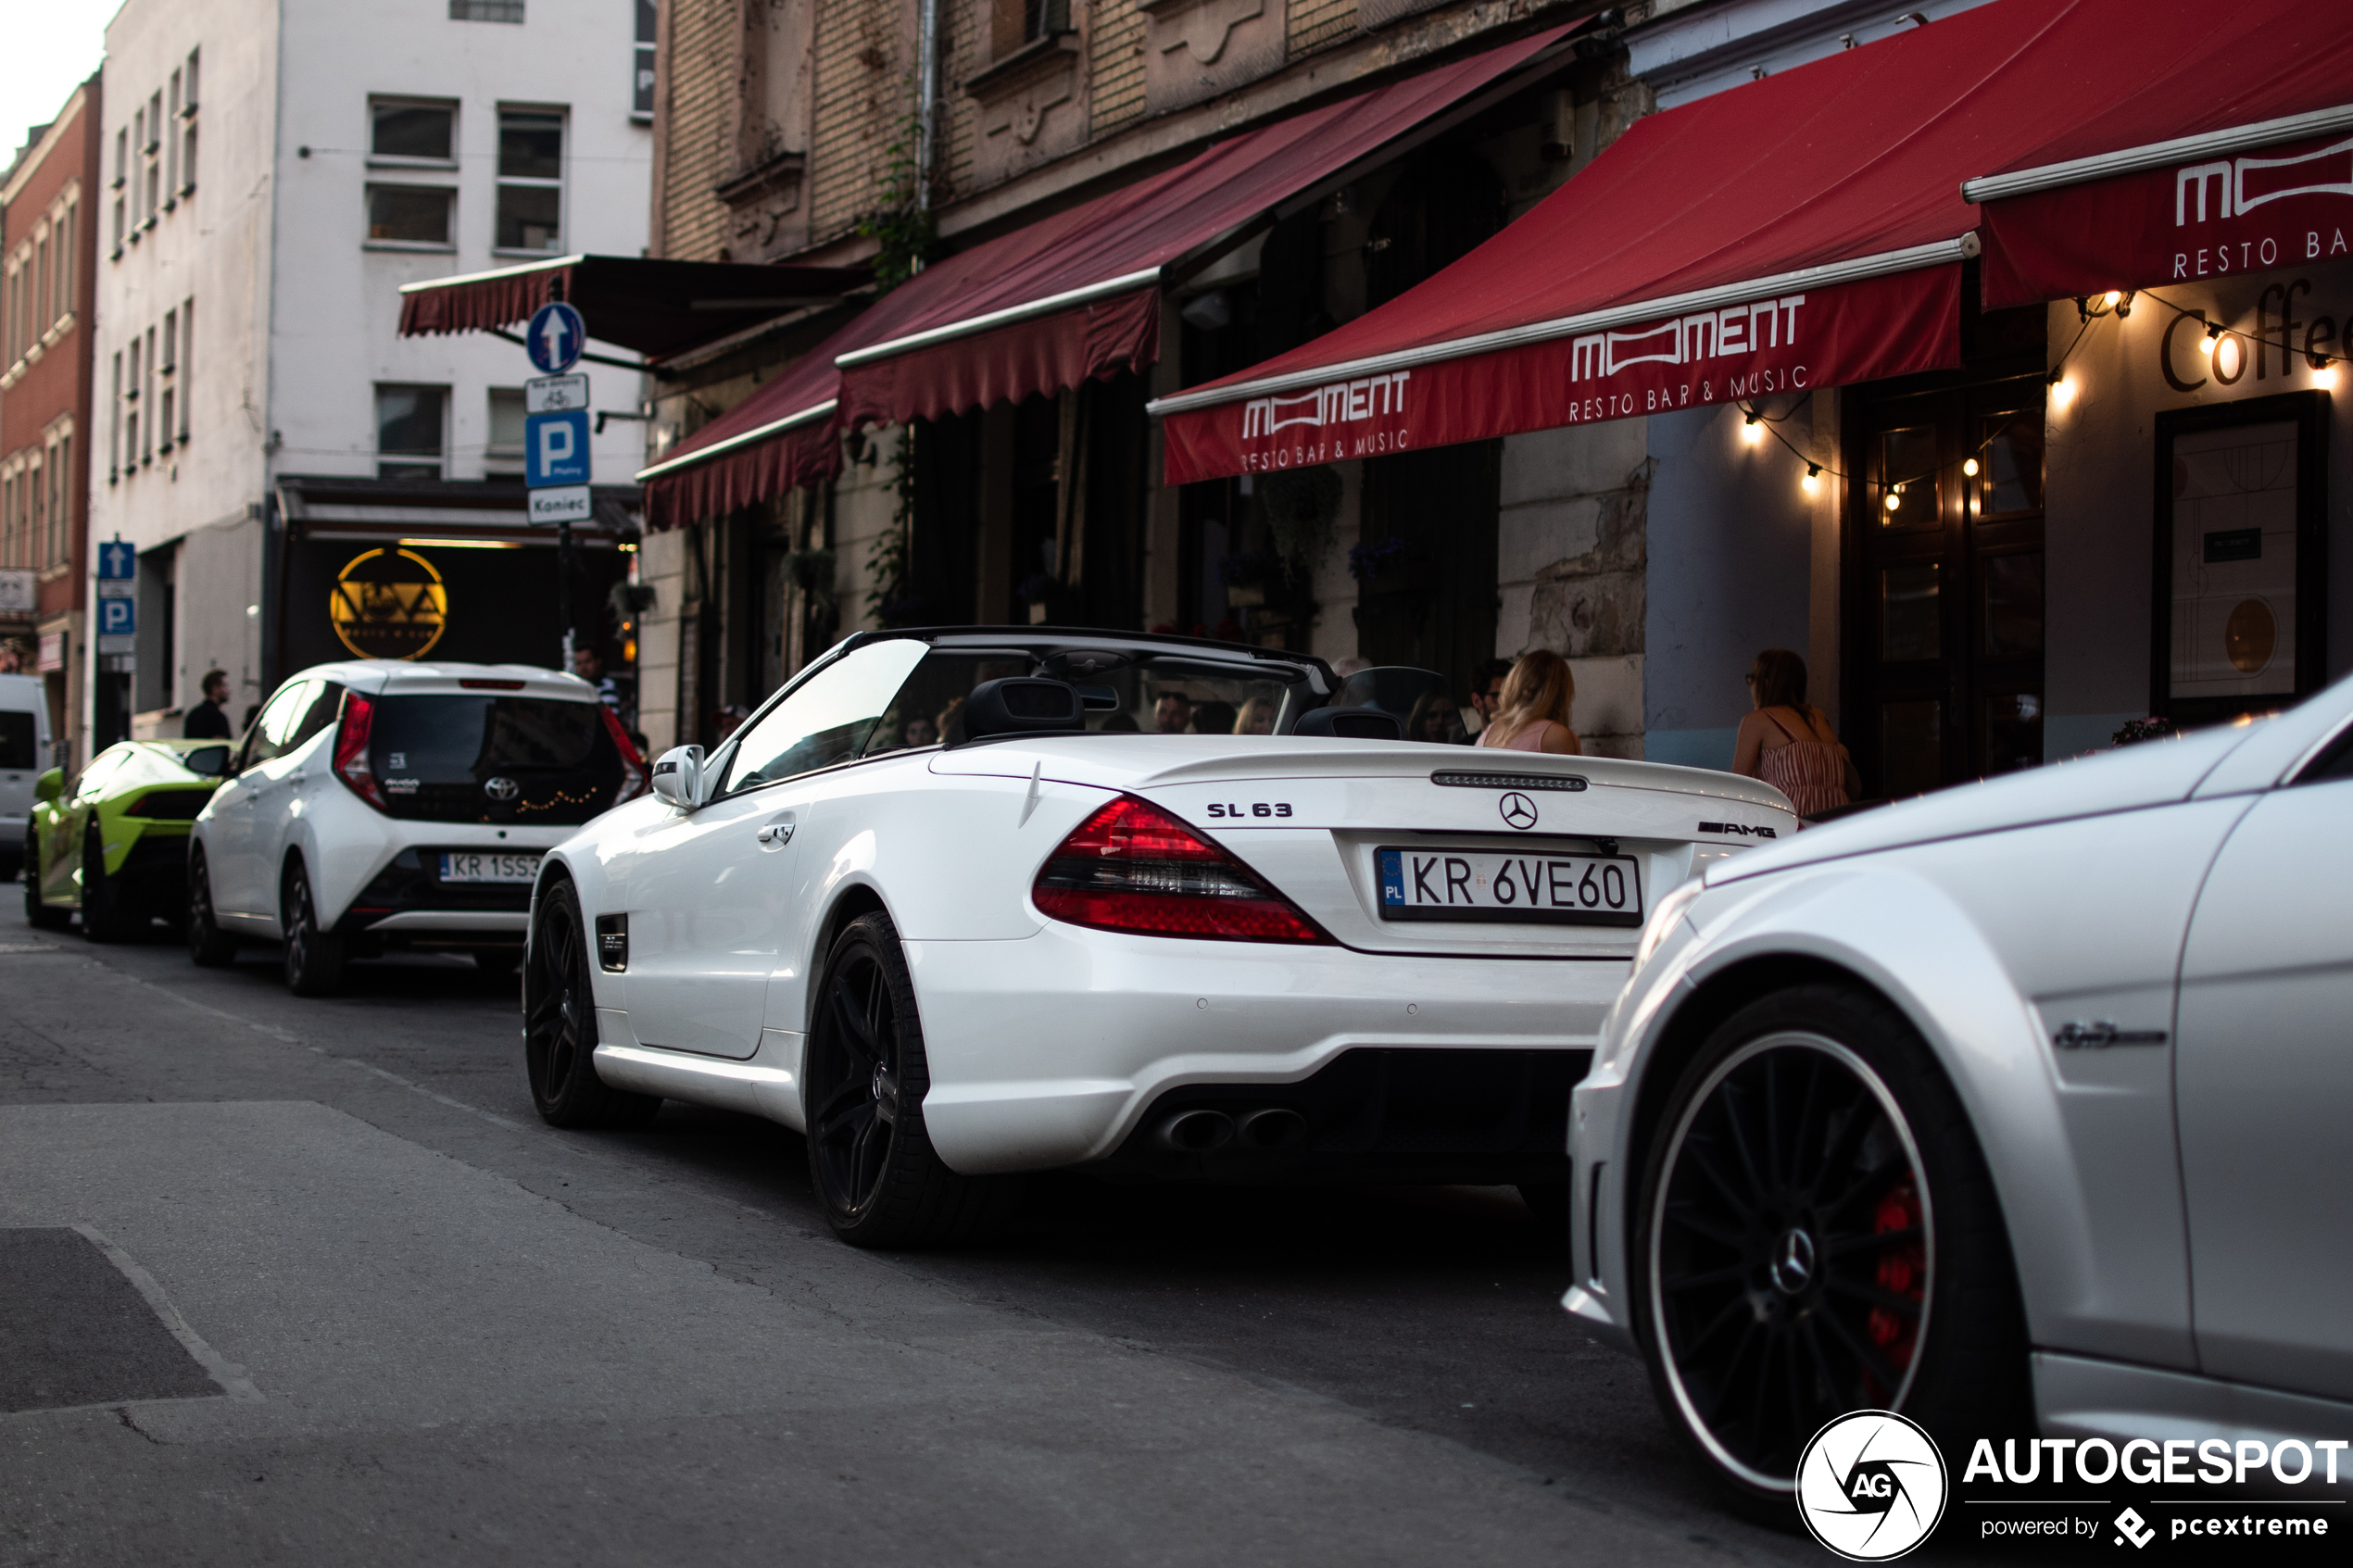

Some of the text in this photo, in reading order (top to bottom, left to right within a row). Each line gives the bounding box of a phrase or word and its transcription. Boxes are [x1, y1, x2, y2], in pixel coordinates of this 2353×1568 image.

[2173, 238, 2276, 278] RESTO
[1571, 295, 1806, 383] MOMENT
[1242, 370, 1410, 439] MOMENT
[1570, 366, 1806, 422] RESTO BAR & MUSIC
[539, 420, 574, 477] P
[1297, 443, 1325, 464] BAR
[1335, 440, 1343, 458] &
[1355, 429, 1408, 456] MUSIC
[535, 497, 585, 512] Koniec
[106, 602, 128, 631] P
[1207, 802, 1292, 818] SL 63
[1724, 822, 1777, 839] AMG
[454, 855, 482, 875] KR
[1386, 885, 1402, 899] PL
[1413, 857, 1626, 909] KR 6VE60
